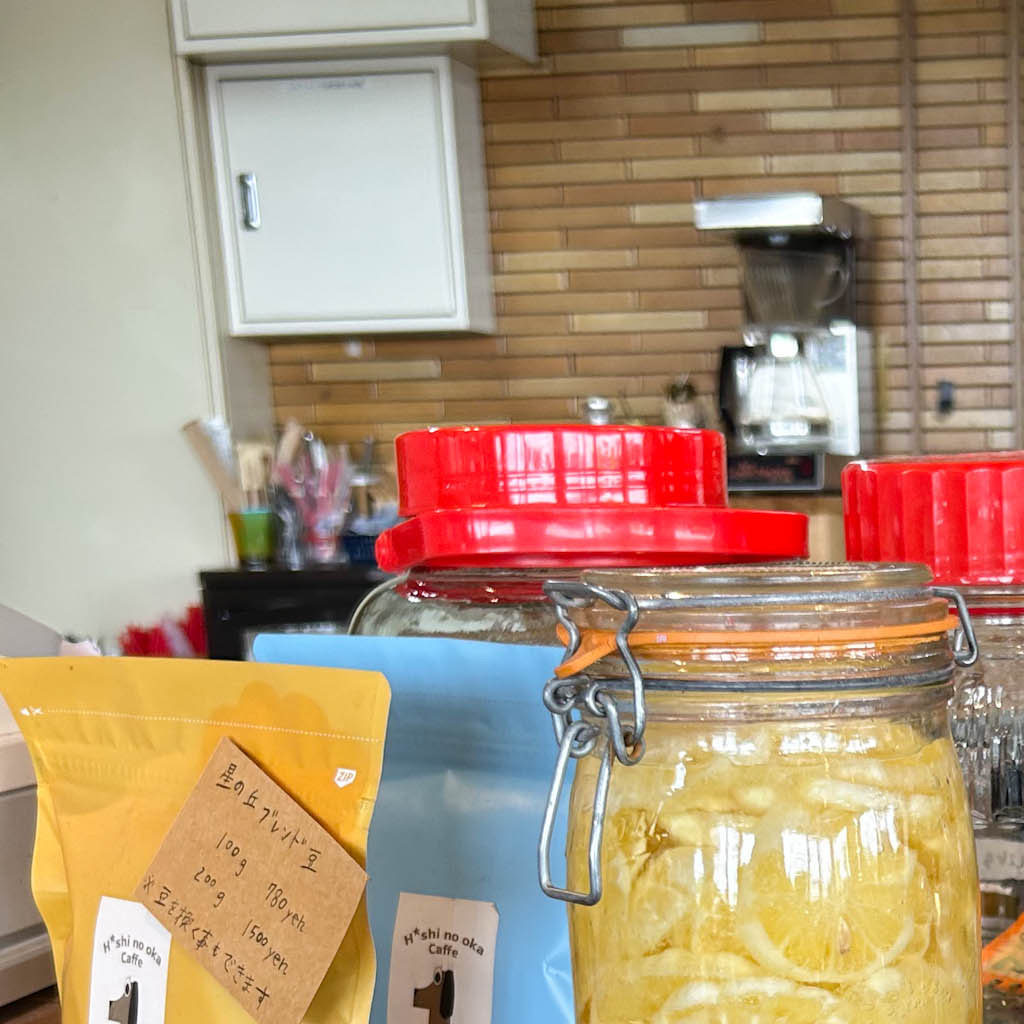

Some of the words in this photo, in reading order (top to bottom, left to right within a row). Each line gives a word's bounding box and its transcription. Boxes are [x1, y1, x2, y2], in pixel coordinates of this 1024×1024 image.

[132, 940, 144, 951] no
[145, 946, 162, 967] oka
[428, 943, 459, 959] Caffe
[444, 931, 459, 943] no
[462, 937, 485, 957] oka
[121, 951, 143, 968] Caffe
